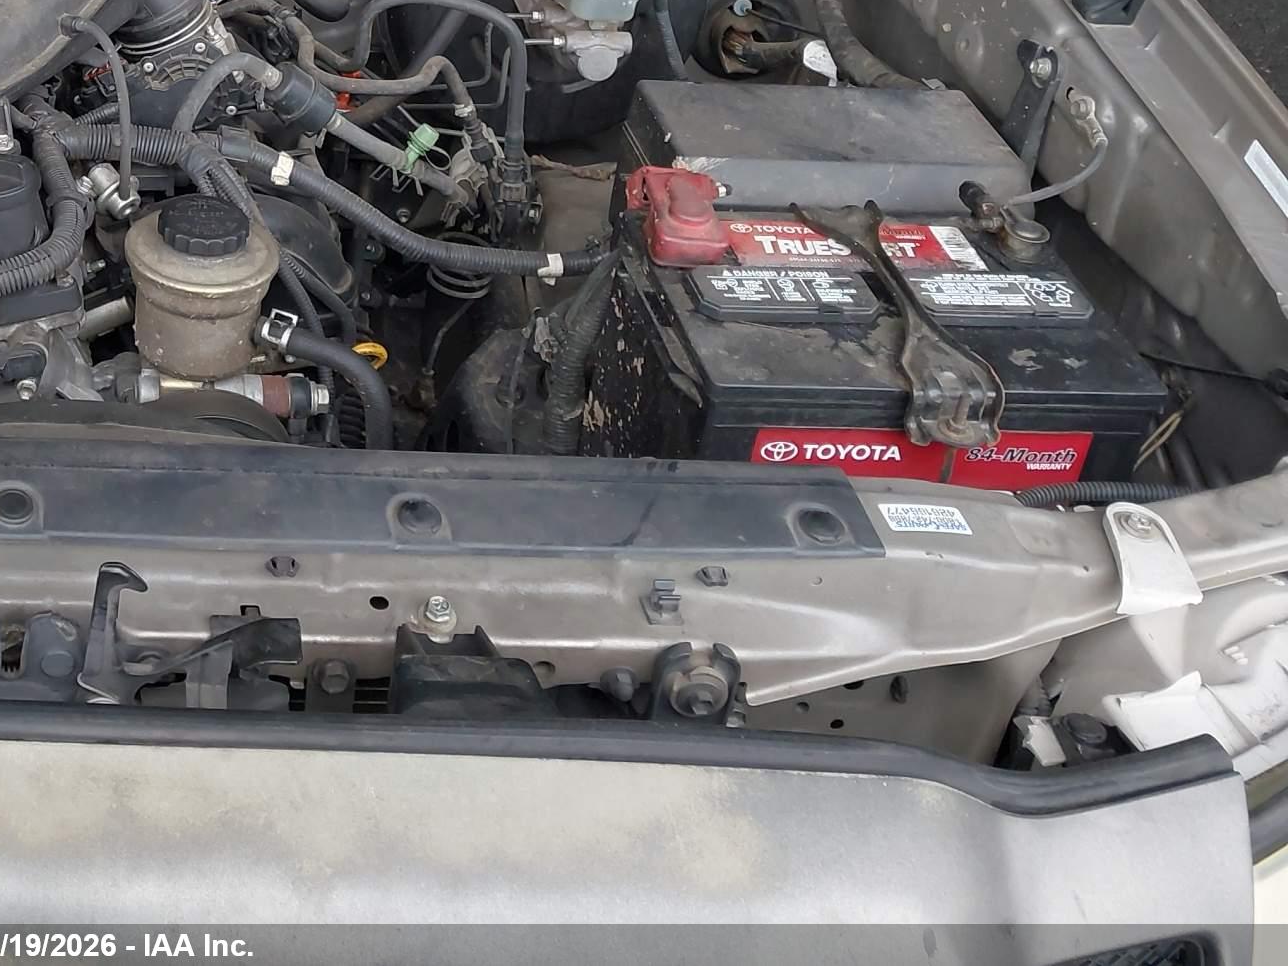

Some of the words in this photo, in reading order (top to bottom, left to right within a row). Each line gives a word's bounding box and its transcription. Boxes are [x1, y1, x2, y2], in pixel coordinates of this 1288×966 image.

[753, 225, 815, 235] TOYOTA
[733, 270, 777, 278] DANGER
[788, 271, 829, 279] POISON
[802, 442, 902, 462] TOYOTA
[966, 445, 1078, 466] 84-Month
[1025, 461, 1074, 471] WARRANTY
